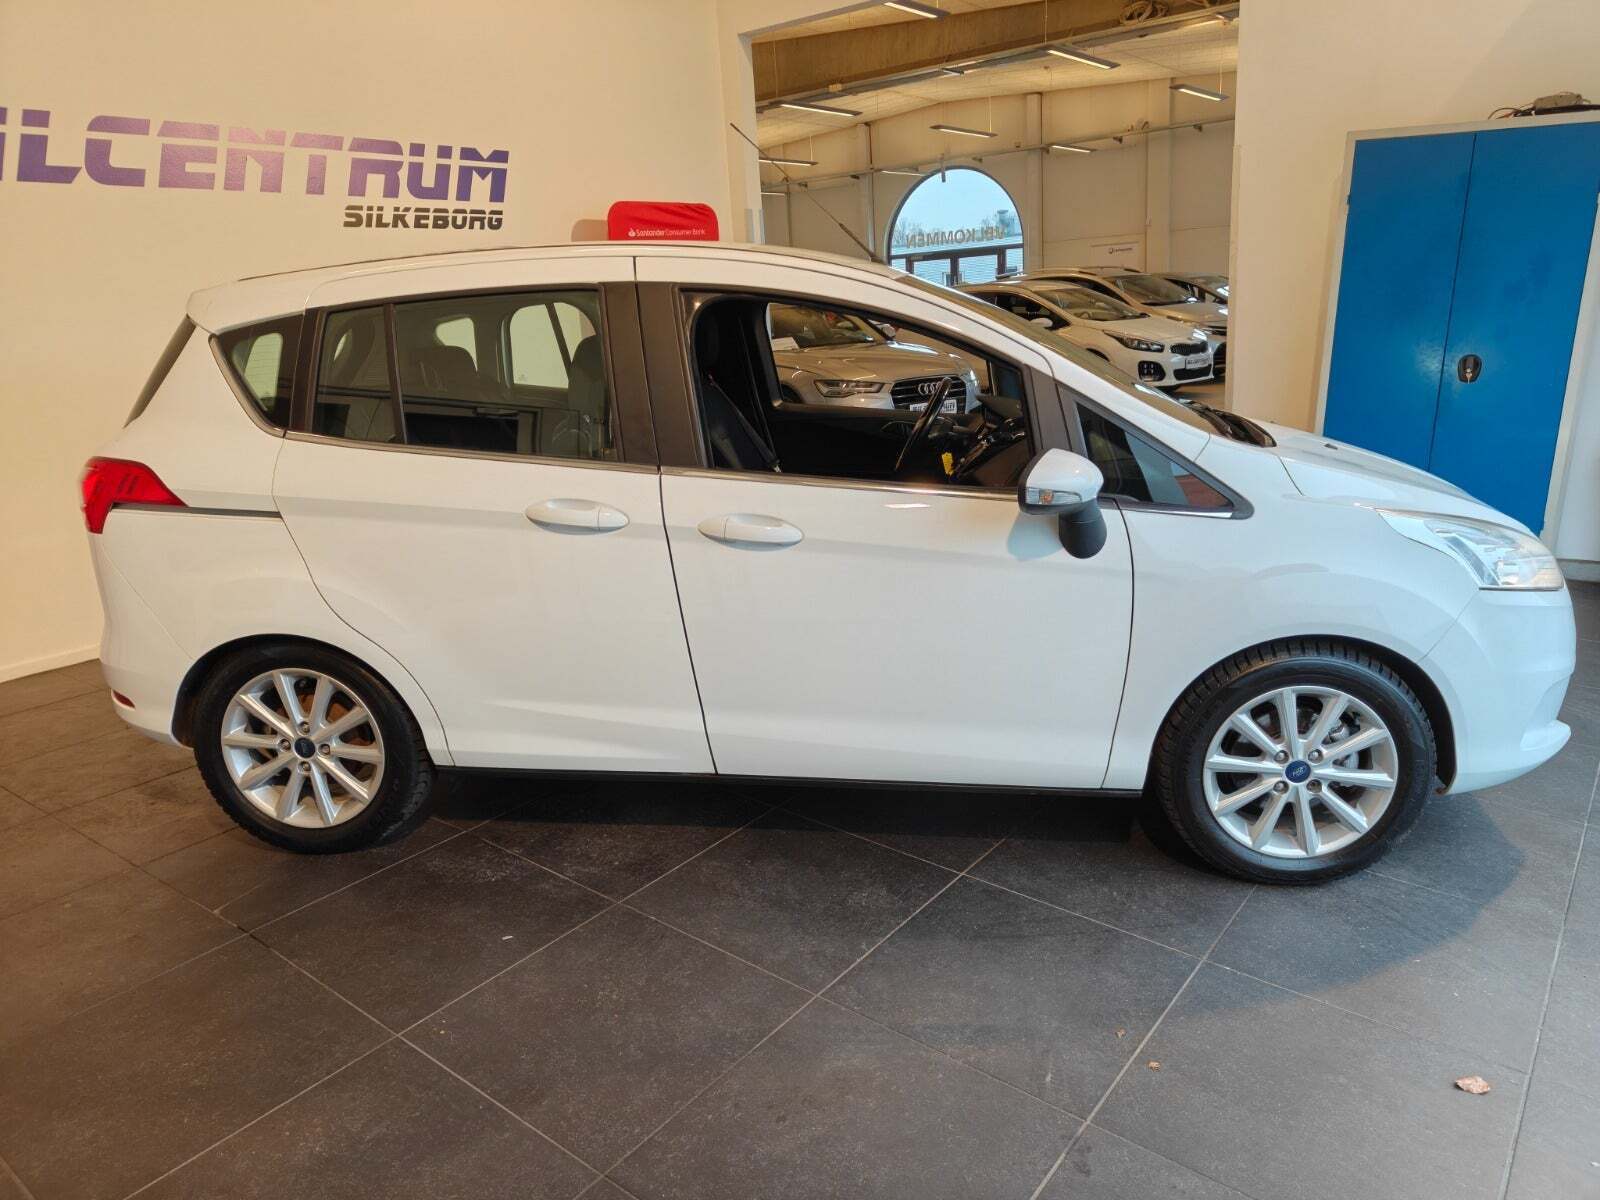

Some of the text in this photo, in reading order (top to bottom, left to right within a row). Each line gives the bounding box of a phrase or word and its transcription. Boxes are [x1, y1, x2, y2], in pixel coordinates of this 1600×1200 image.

[0, 107, 510, 203] LCENTRUM
[343, 205, 503, 230] SILKEBORG
[635, 228, 665, 237] Santander
